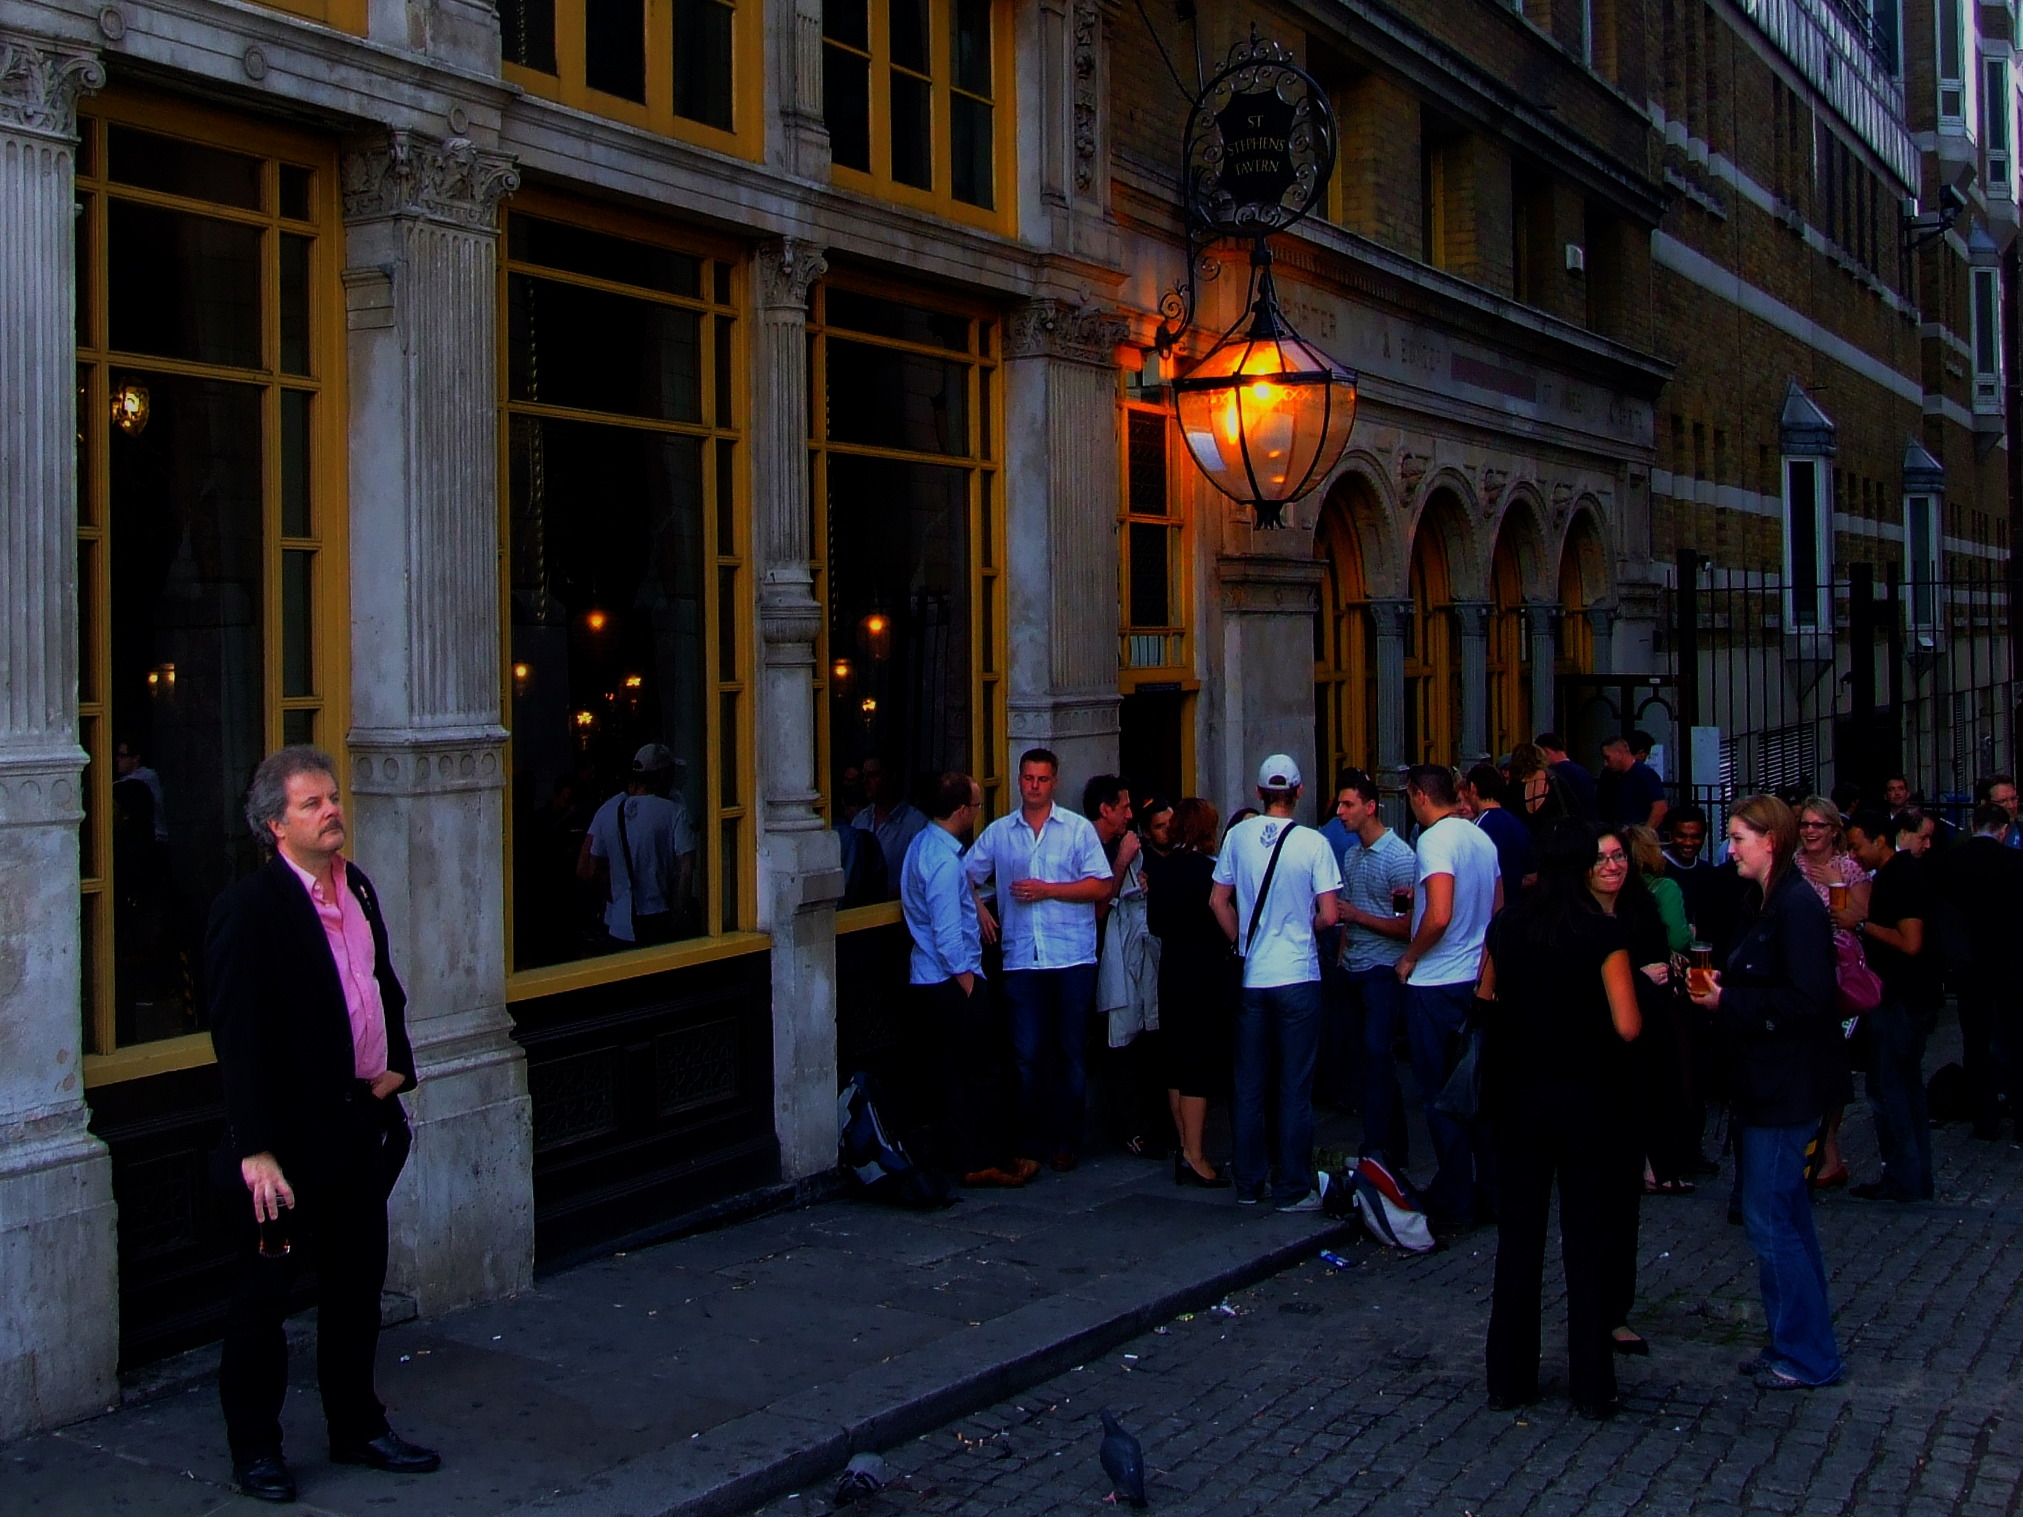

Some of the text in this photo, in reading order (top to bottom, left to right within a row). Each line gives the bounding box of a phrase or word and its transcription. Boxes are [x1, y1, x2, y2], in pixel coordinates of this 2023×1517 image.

[1248, 115, 1263, 128] ST
[1227, 137, 1286, 156] STEPHENS
[1235, 159, 1280, 176] TAVERN
